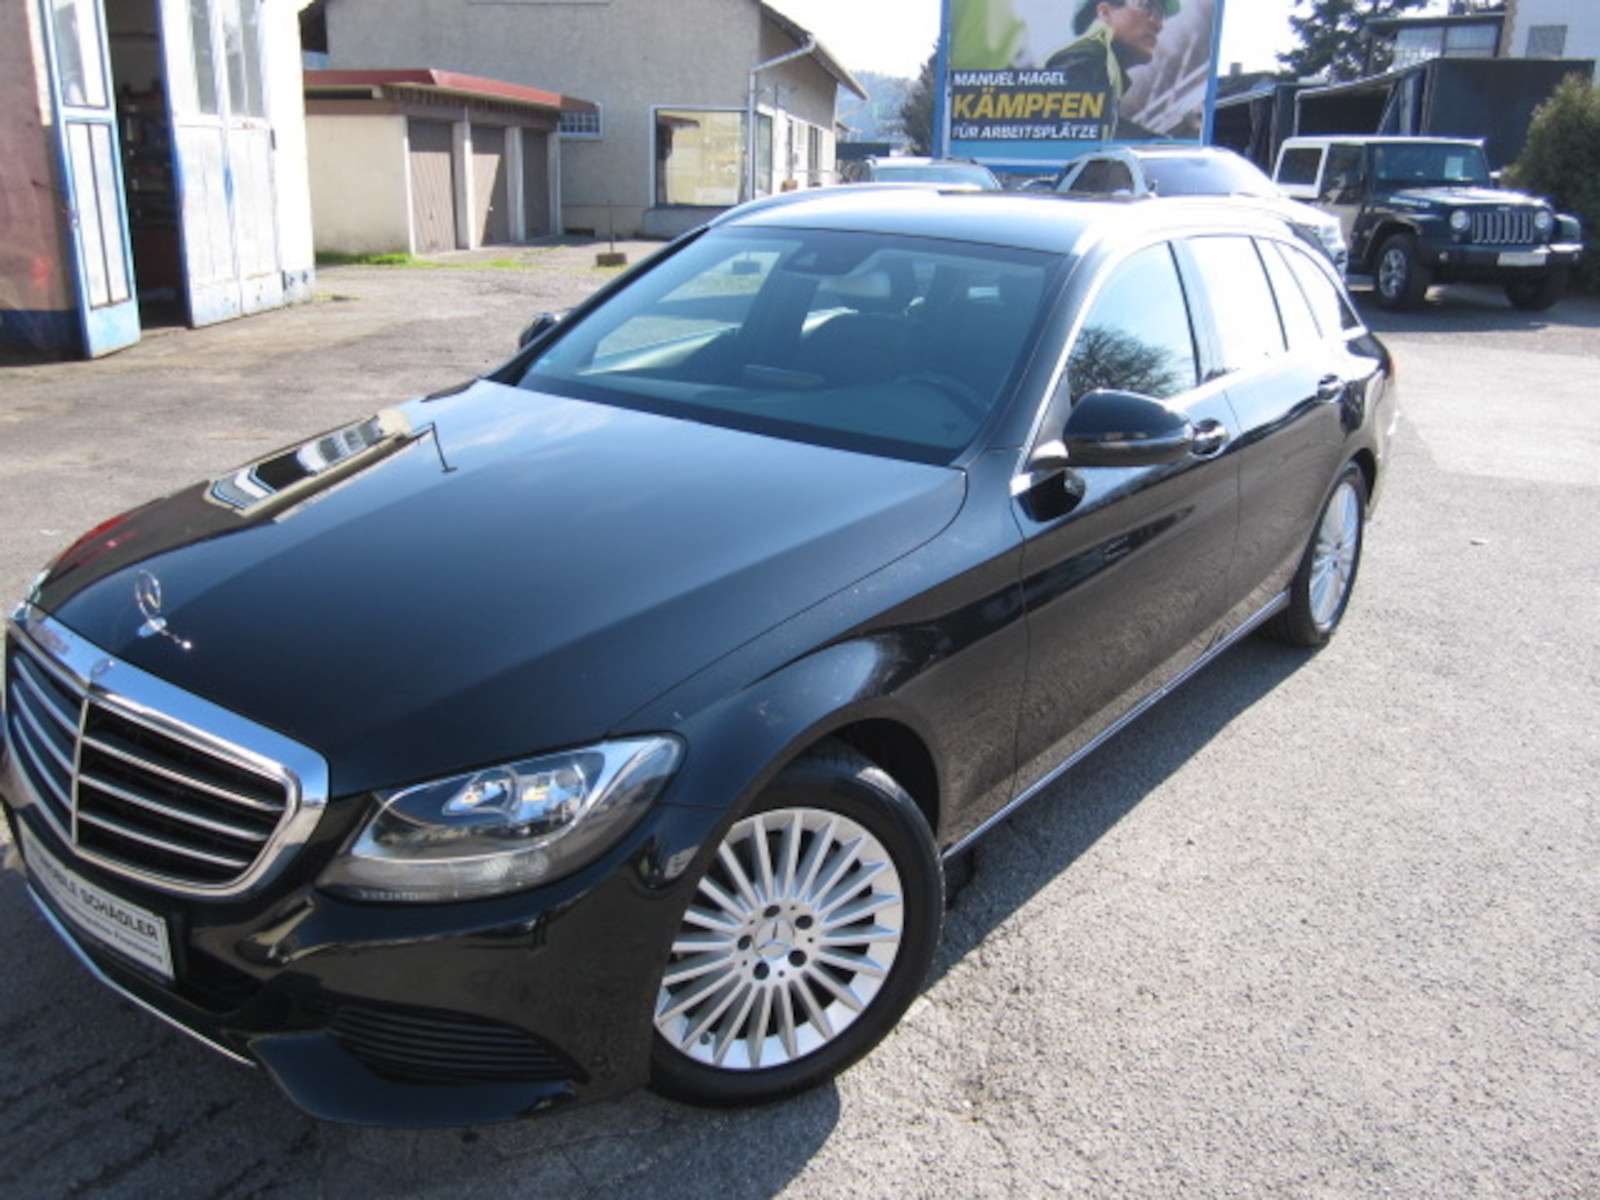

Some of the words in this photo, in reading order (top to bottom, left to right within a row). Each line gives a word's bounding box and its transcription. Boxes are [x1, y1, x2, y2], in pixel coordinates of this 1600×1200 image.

[953, 71, 1015, 86] MANUEL
[1018, 71, 1066, 86] HAGEL
[953, 87, 1105, 119] KÄMPFEN
[952, 122, 979, 139] FÜR
[981, 122, 1098, 139] ARBEITSPLÄTZE
